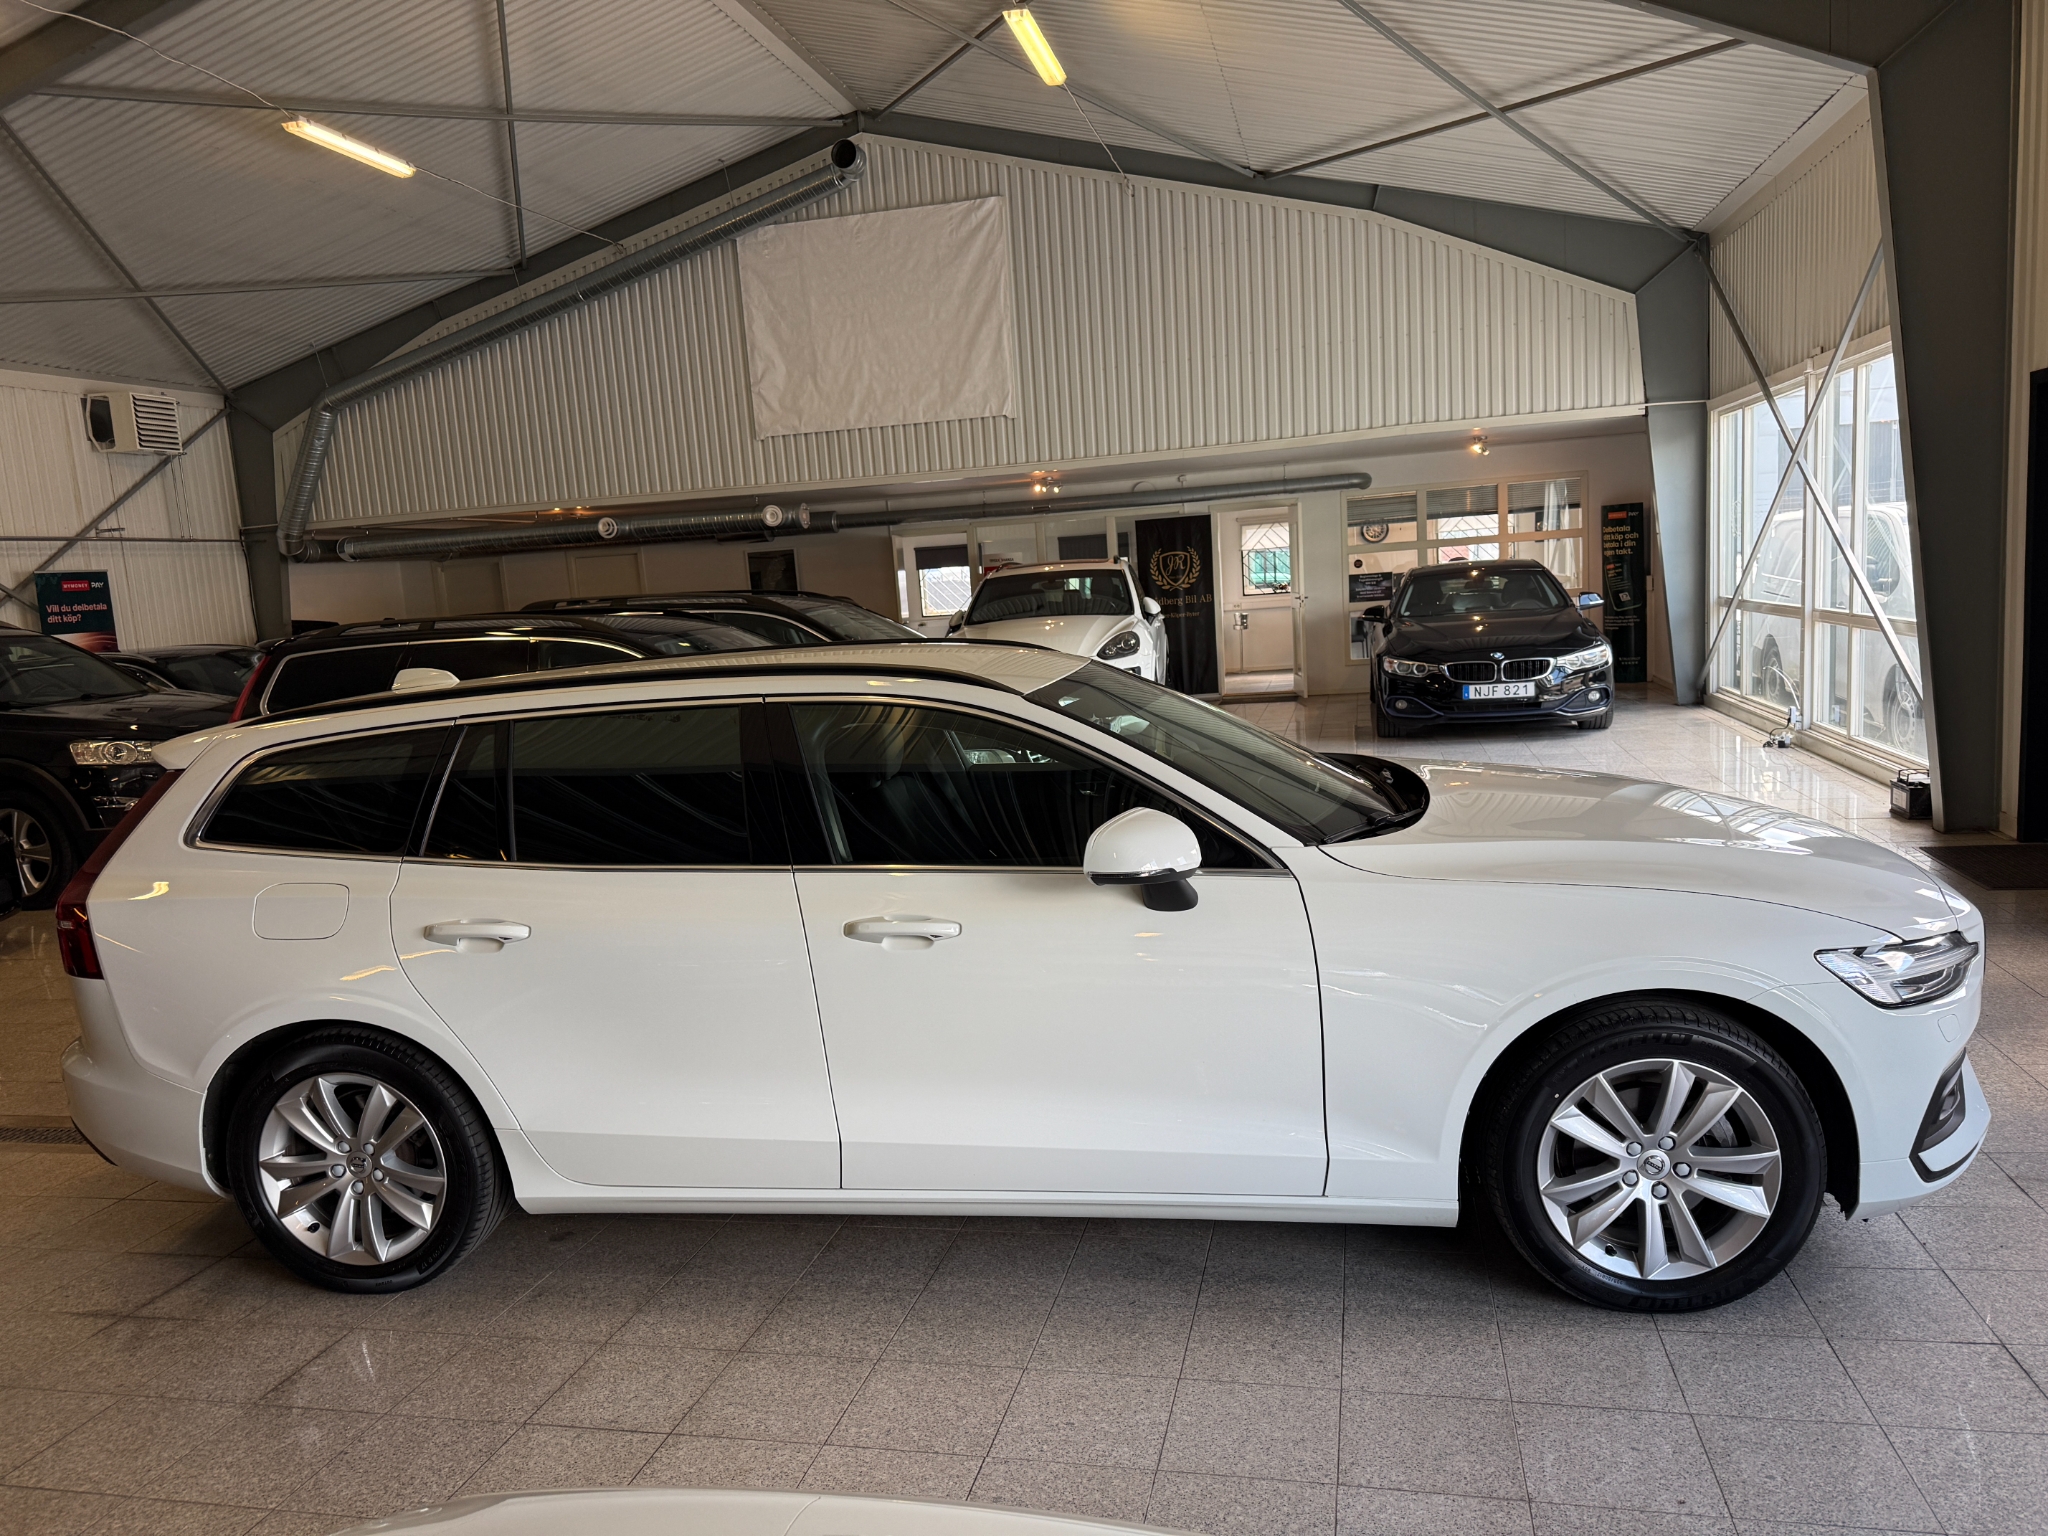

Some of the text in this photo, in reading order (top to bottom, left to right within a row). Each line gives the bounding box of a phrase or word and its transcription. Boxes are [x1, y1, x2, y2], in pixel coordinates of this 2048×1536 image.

[1611, 533, 1624, 541] köp
[1185, 594, 1197, 604] Bil
[1199, 593, 1213, 603] AB
[46, 603, 108, 613] Vill du delbetala
[47, 614, 82, 624] ditt köp?
[1474, 685, 1499, 697] NJF
[1503, 684, 1528, 696] 821
